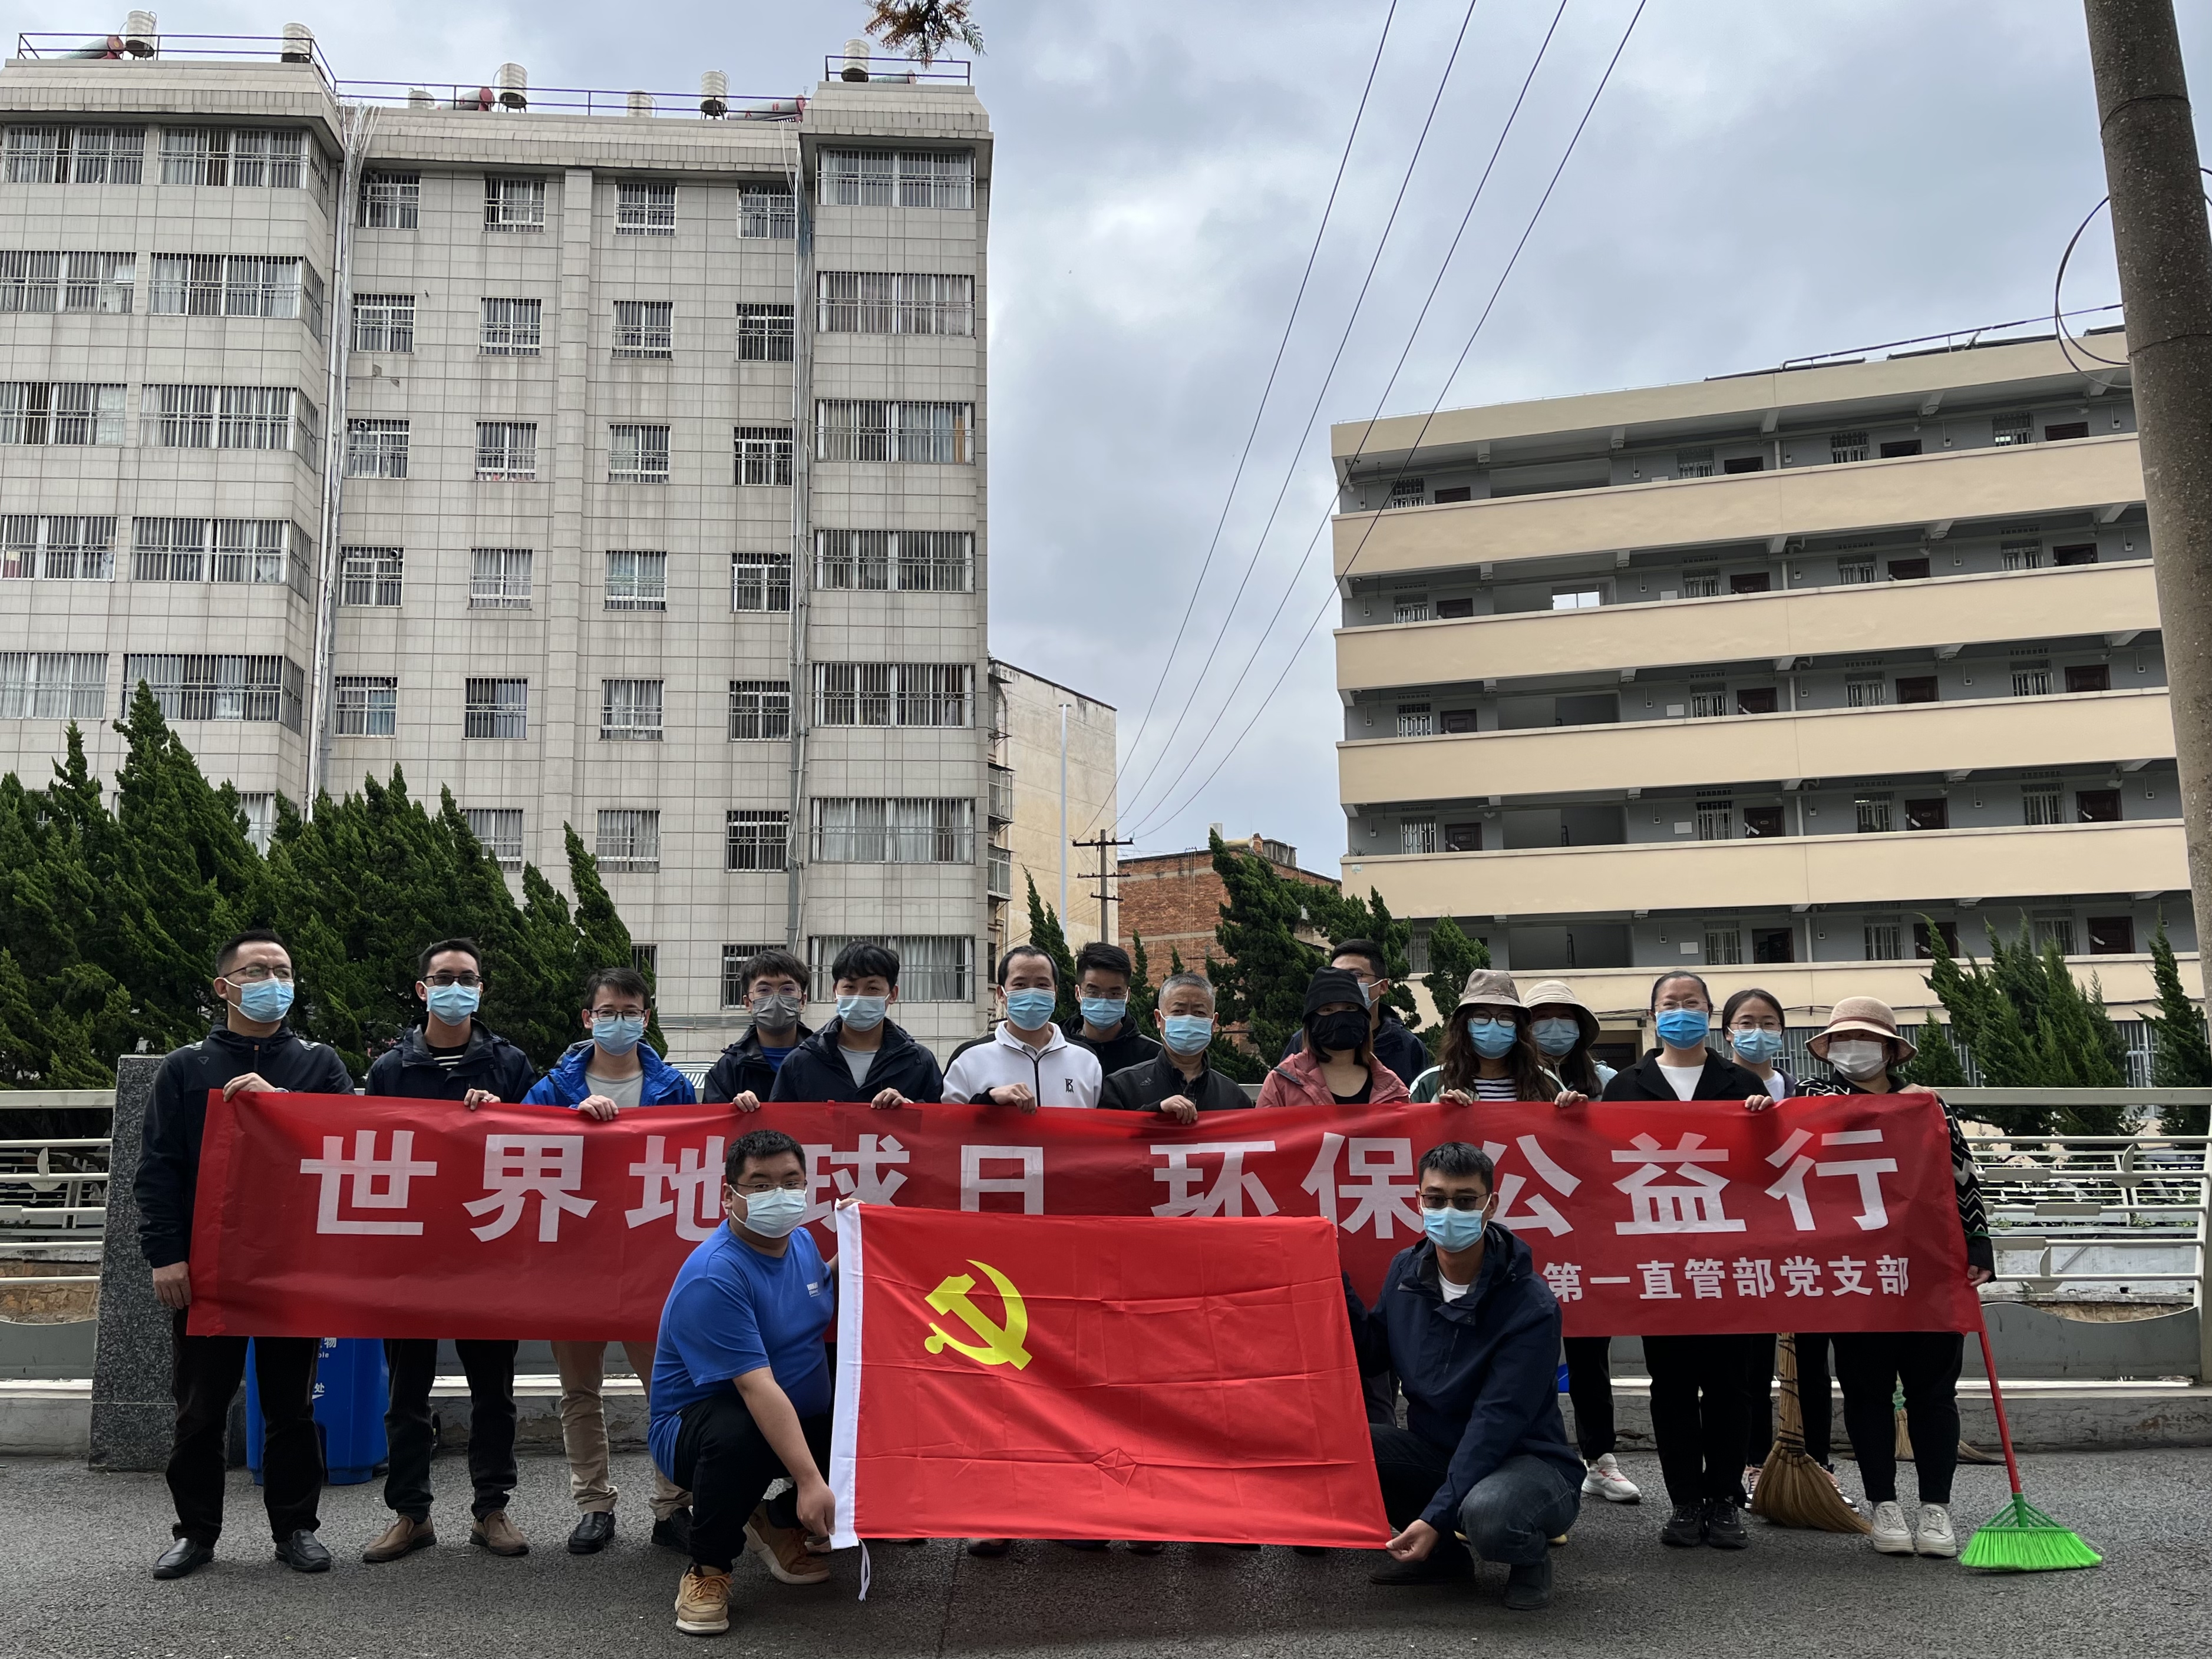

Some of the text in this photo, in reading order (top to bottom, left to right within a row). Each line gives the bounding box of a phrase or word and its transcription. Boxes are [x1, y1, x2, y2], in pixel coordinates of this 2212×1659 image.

[300, 1128, 1899, 1241] 世界地球日 环保公益行
[1542, 1254, 1909, 1303] 第一直管部党支部
[320, 1337, 336, 1349] 物
